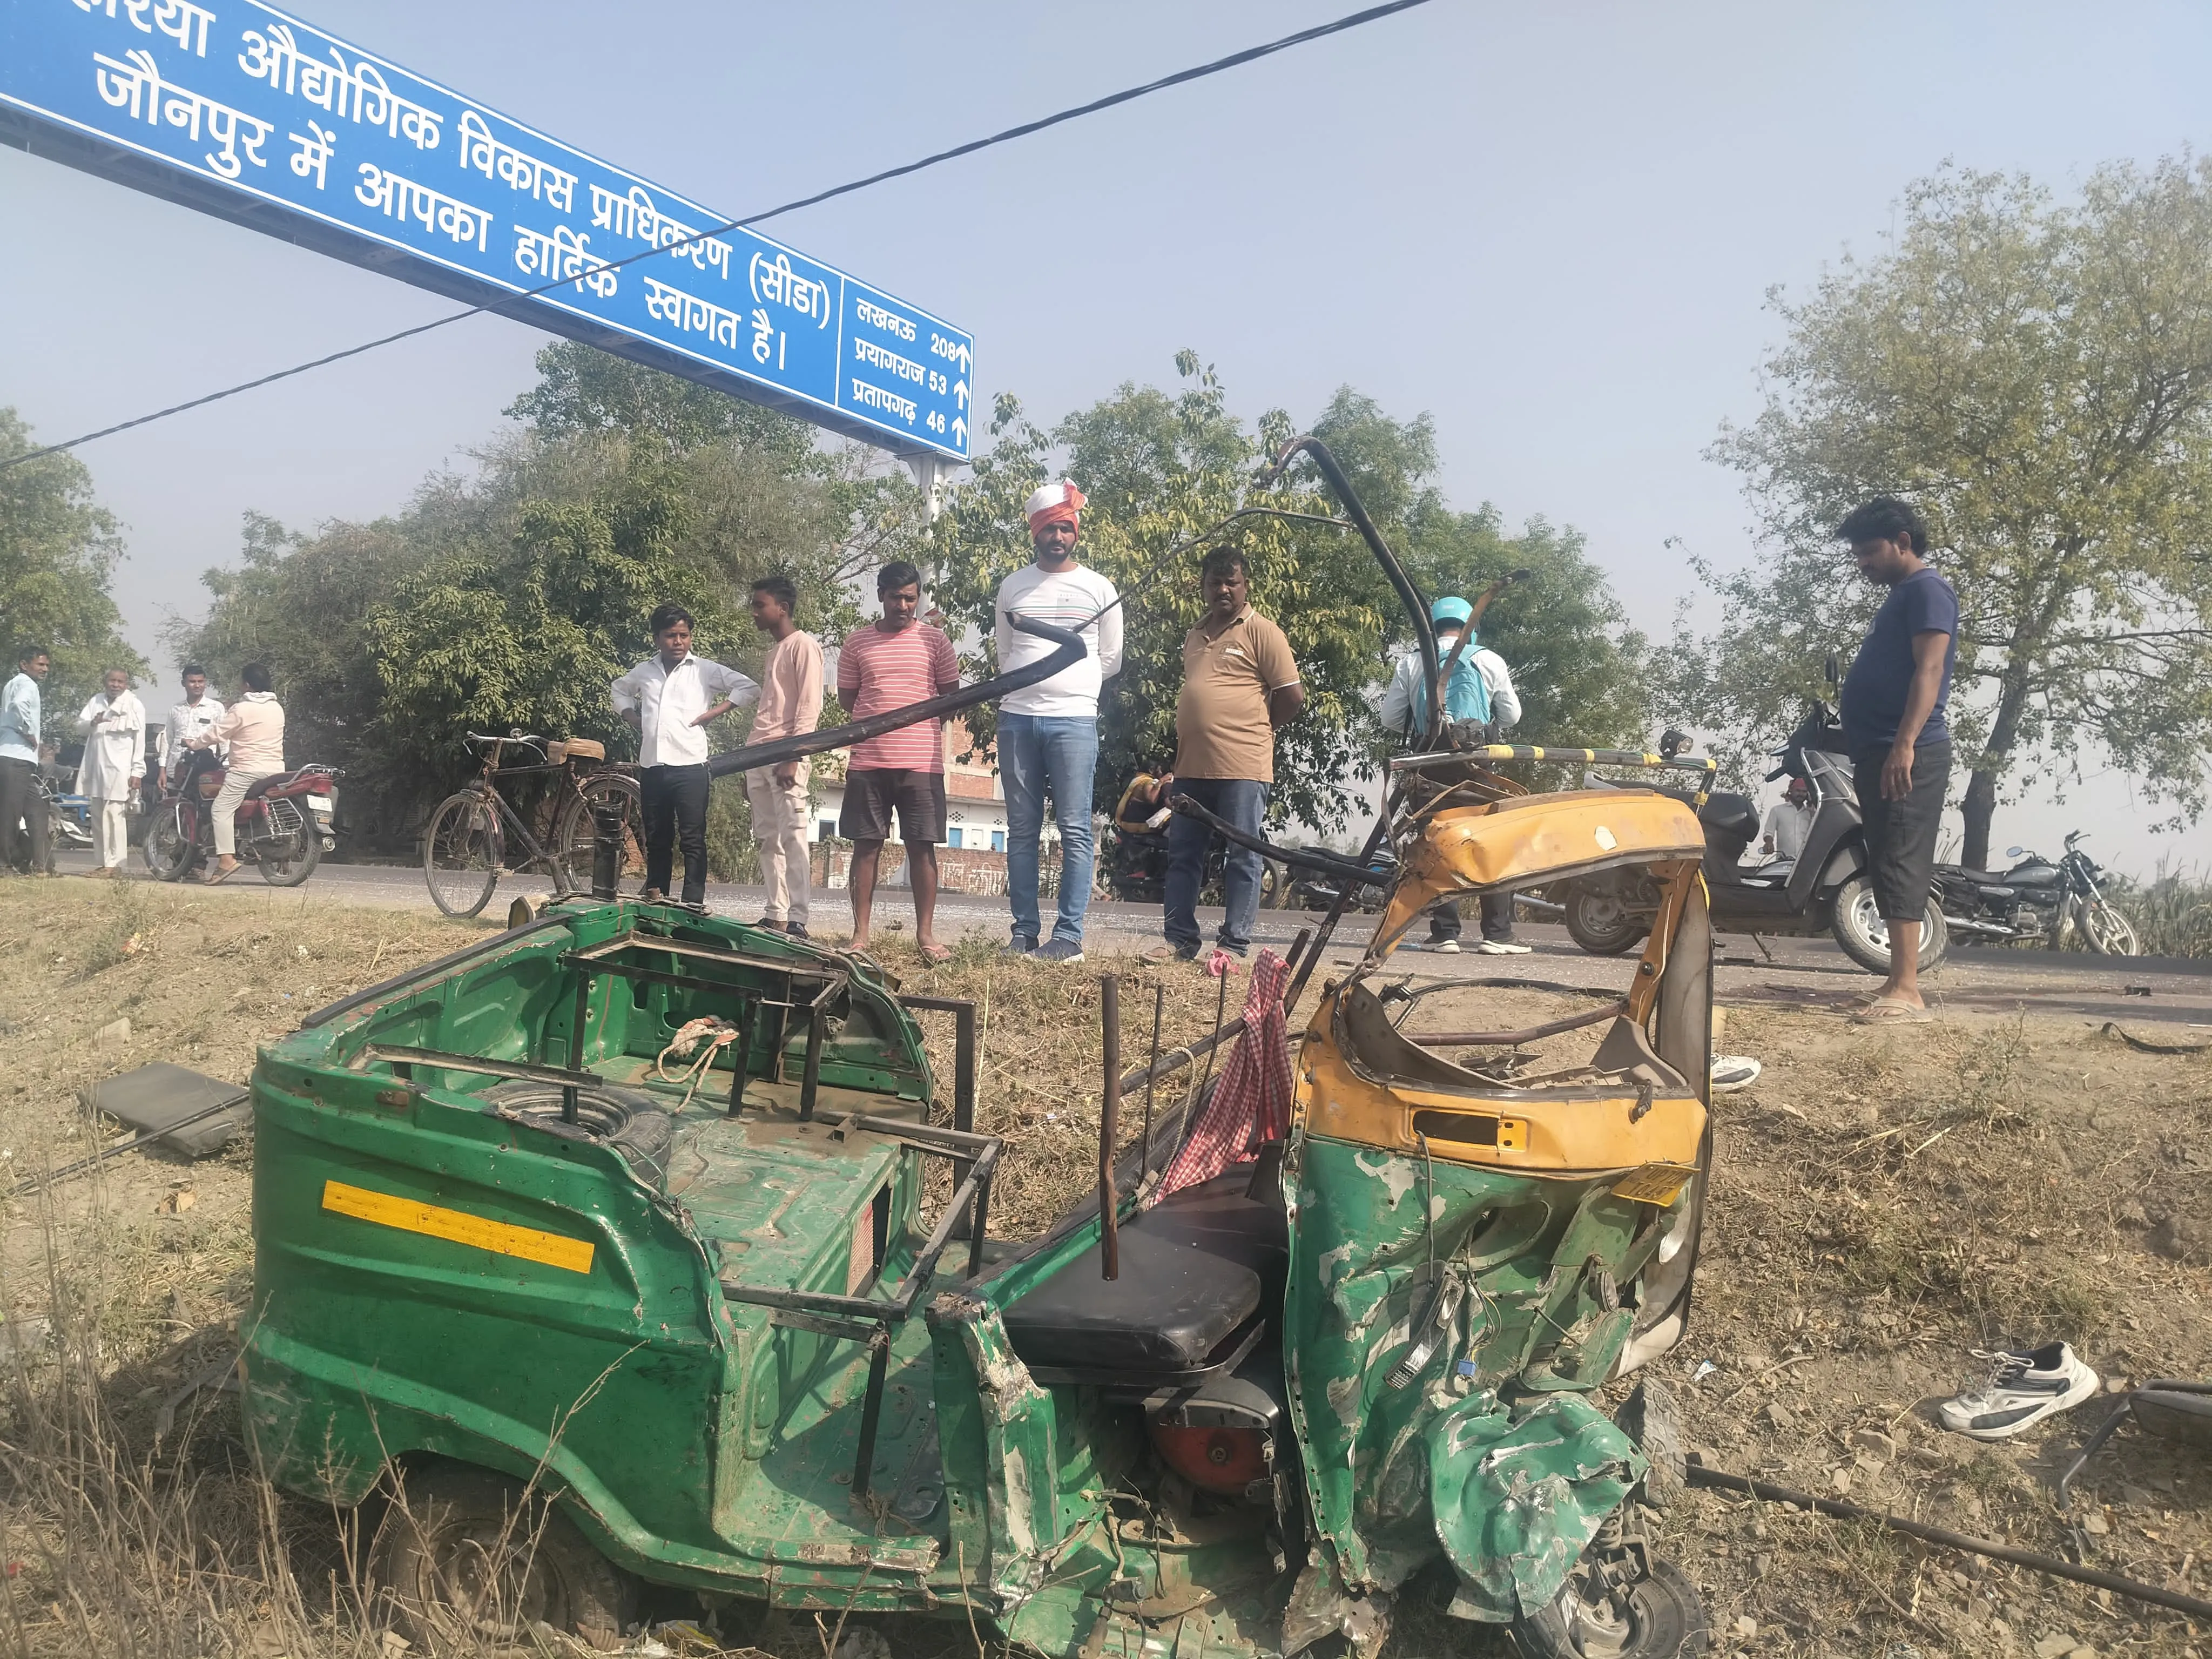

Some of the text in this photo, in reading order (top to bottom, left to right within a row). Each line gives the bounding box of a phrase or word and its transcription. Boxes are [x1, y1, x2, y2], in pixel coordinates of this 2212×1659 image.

[93, 49, 274, 179] जौनपुर
[289, 120, 336, 191] में
[354, 163, 494, 252] आपका
[514, 225, 621, 298] हार्दिक
[644, 276, 741, 349] स्वागत
[238, 24, 443, 150] औद्योगिक
[458, 110, 578, 214] विकास
[589, 183, 733, 280] प्राधिकरण
[750, 252, 830, 329] (सीडा)
[856, 298, 956, 362] लखनऊ 208
[854, 337, 947, 395] प्रयागराज 53
[852, 378, 945, 434] प्रतापगढ़ 46
